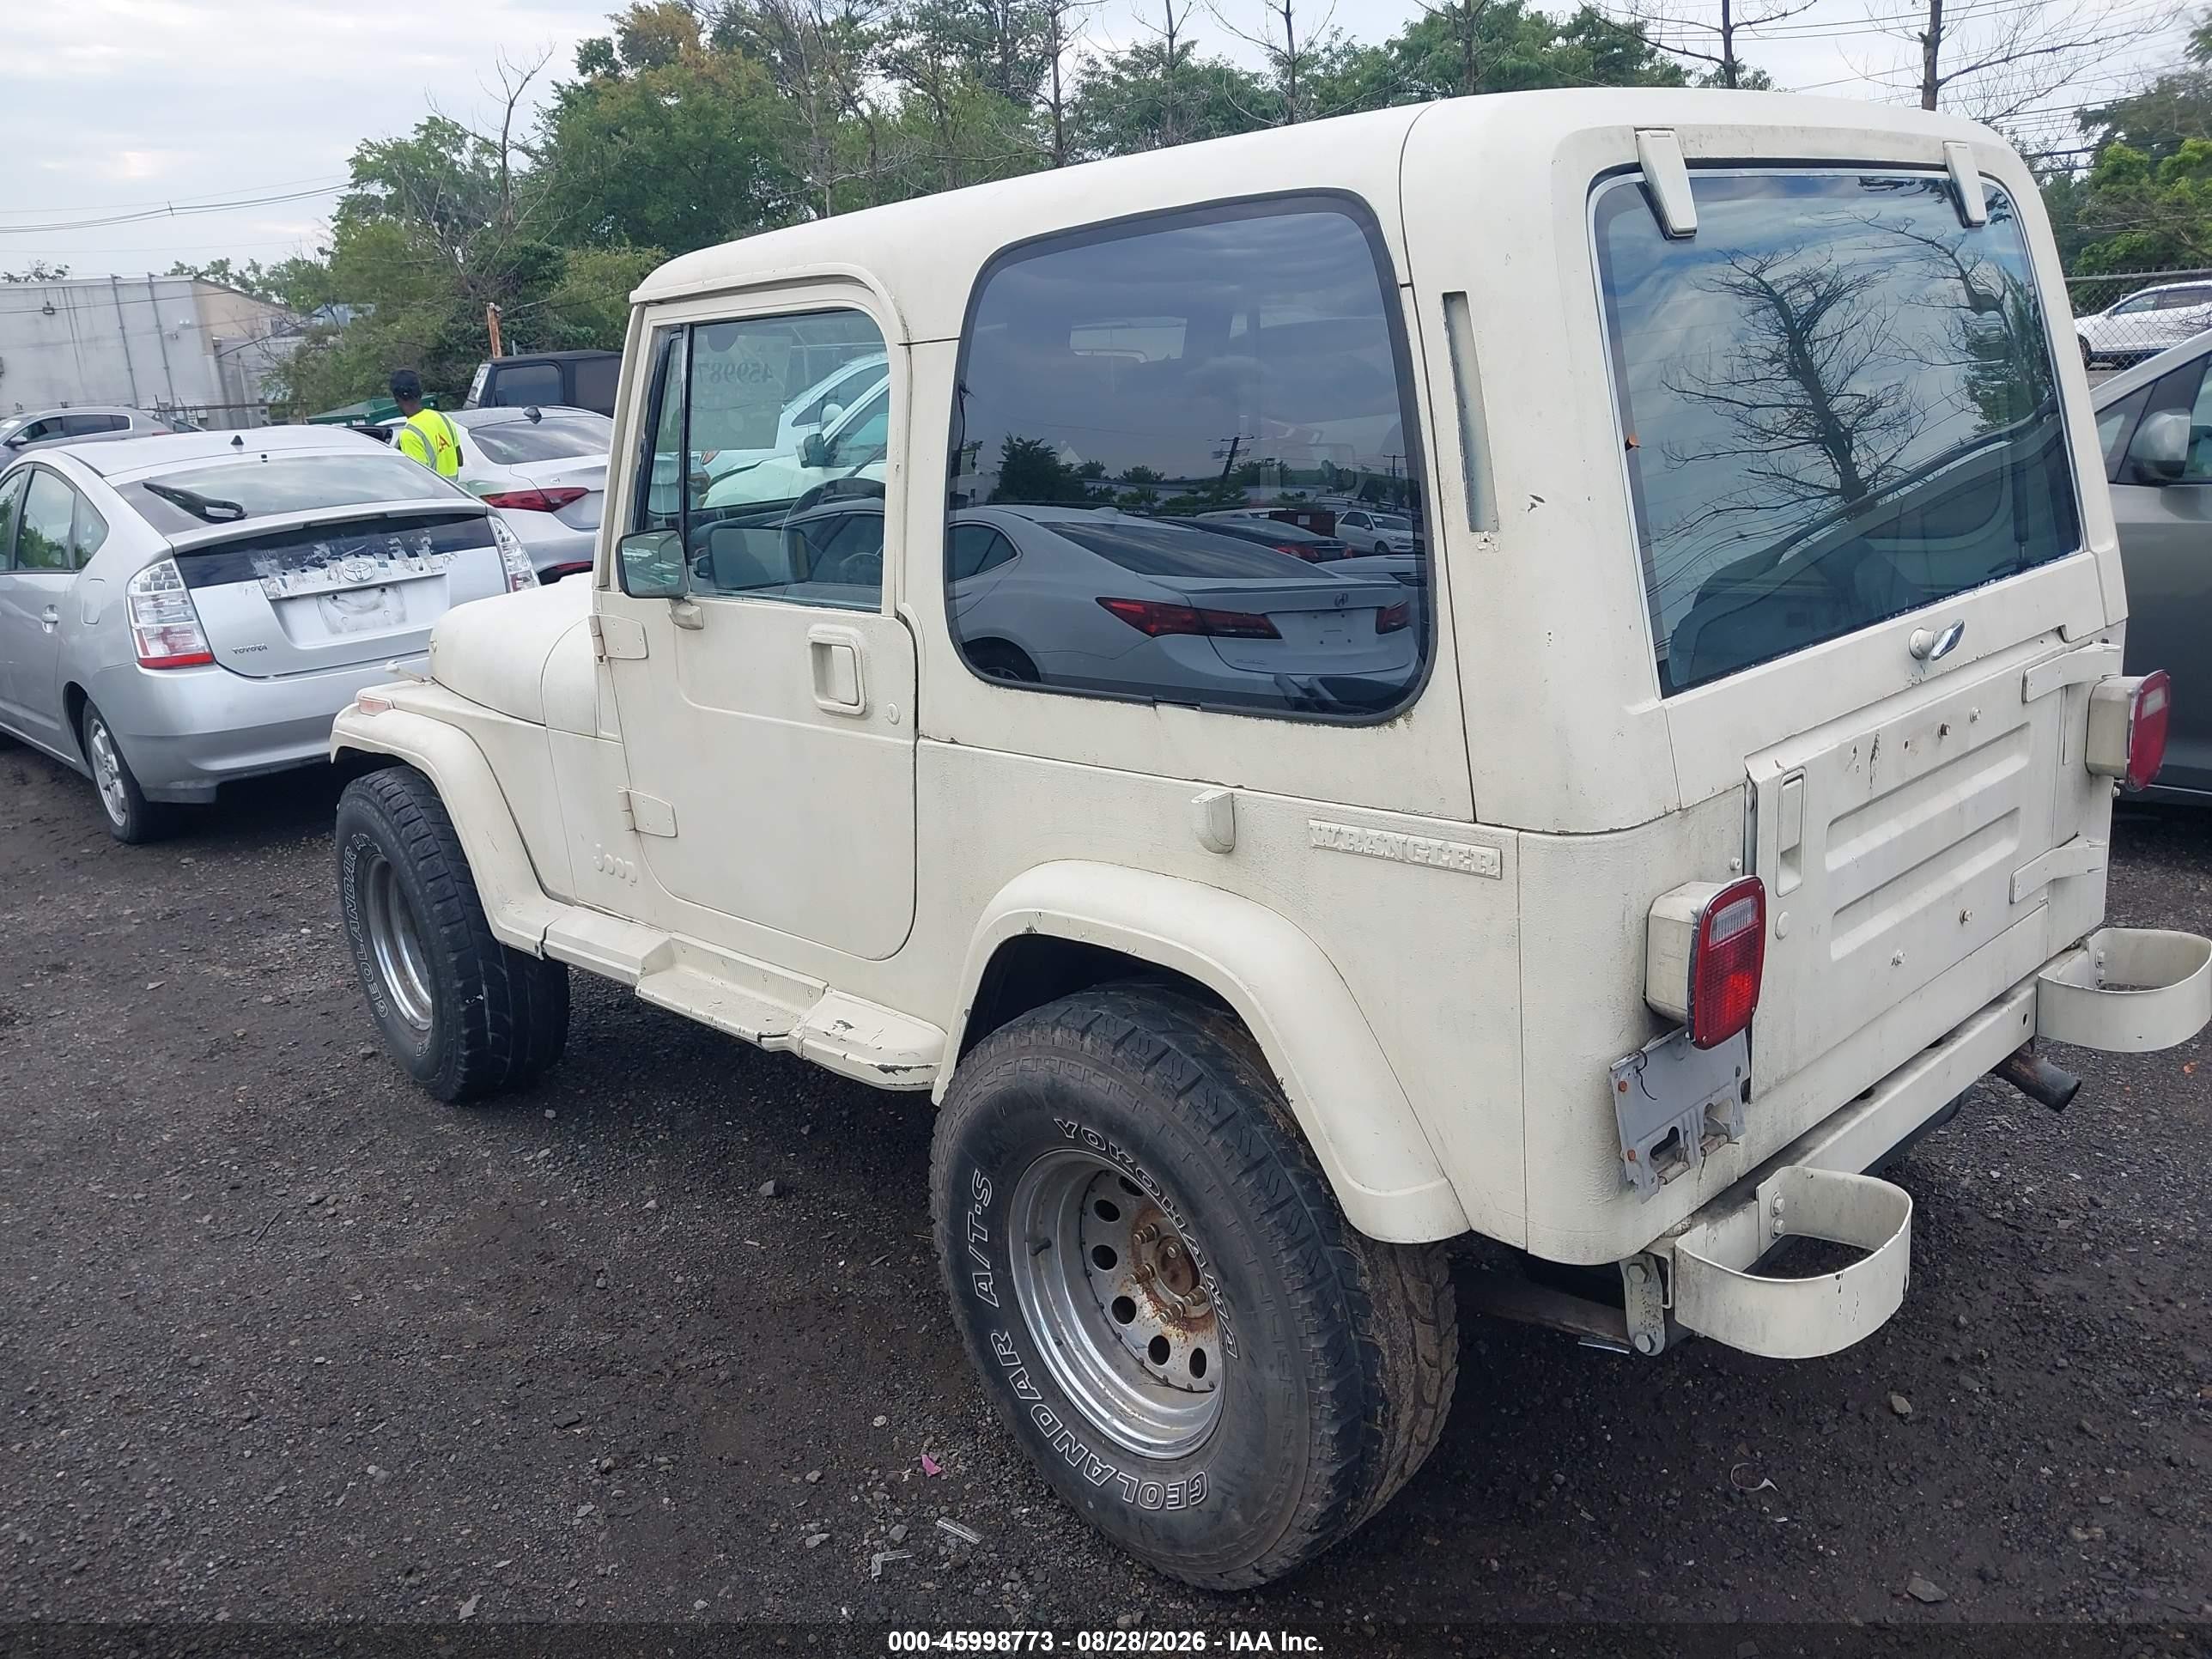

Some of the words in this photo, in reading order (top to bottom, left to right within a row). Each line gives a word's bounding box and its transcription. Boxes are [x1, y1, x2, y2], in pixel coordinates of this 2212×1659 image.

[232, 644, 268, 654] TOYOTA
[343, 845, 389, 1018] GEOLANDAR
[1310, 823, 1501, 878] WRANGLER
[1054, 1118, 1238, 1359] YOKOHAMA
[991, 1330, 1207, 1510] GEOLANDAR
